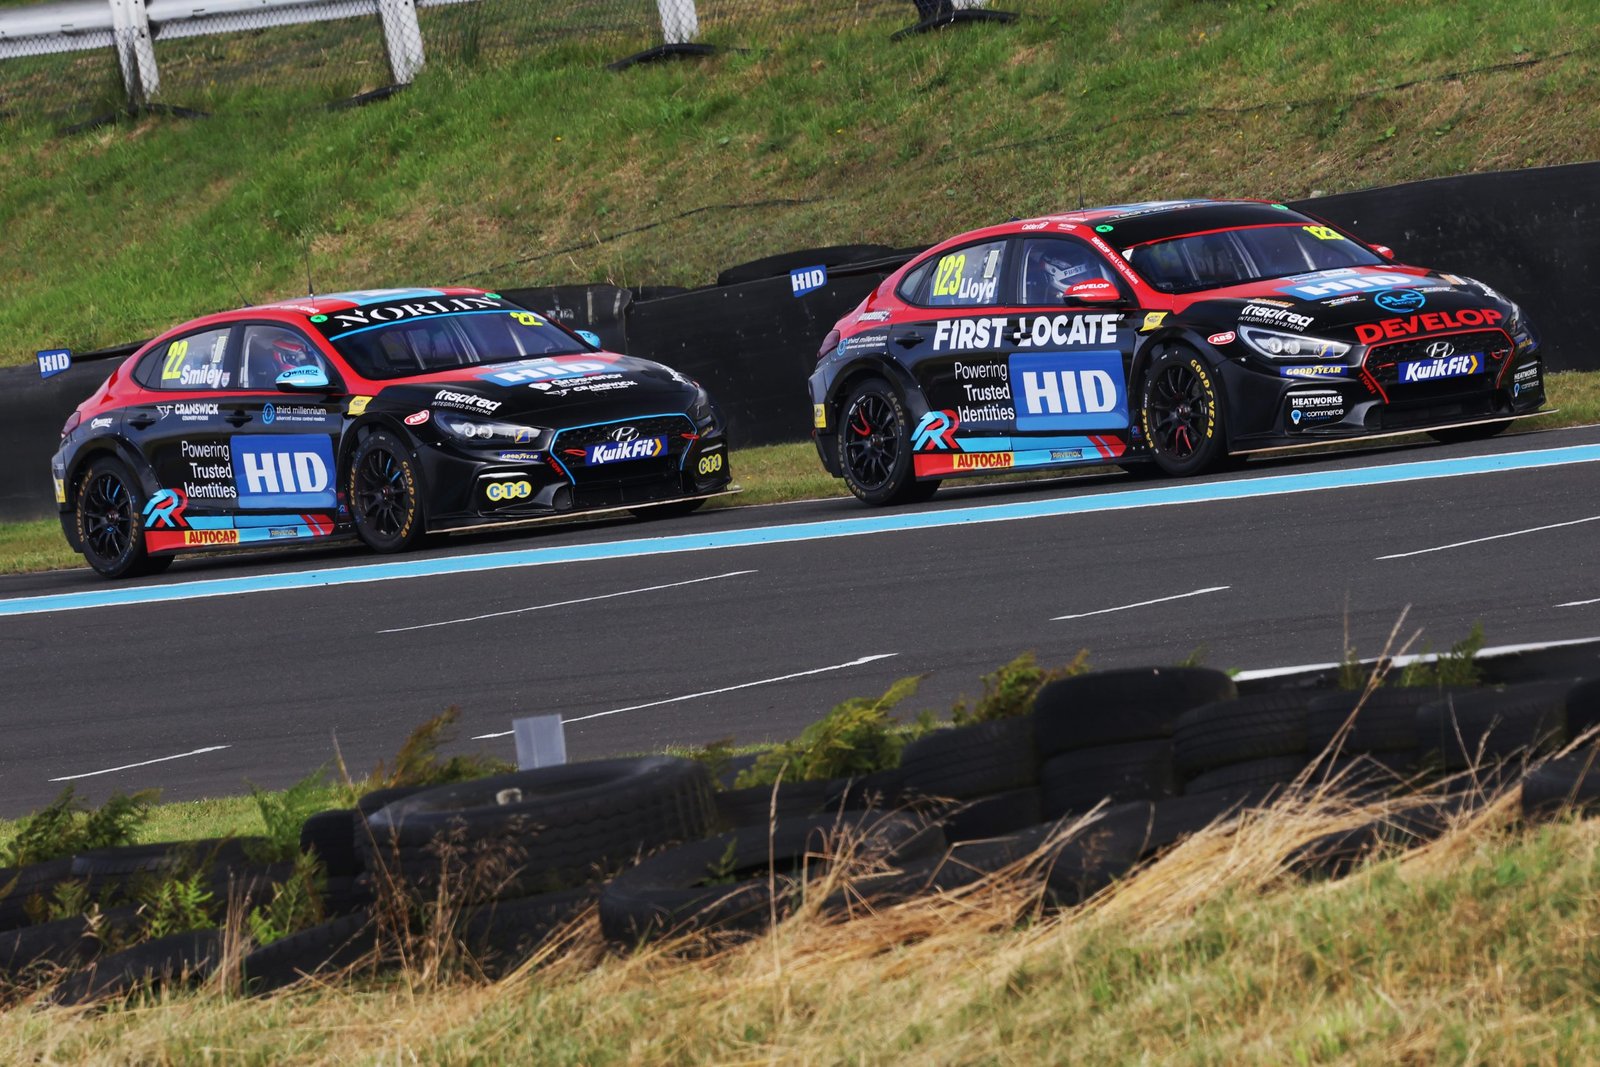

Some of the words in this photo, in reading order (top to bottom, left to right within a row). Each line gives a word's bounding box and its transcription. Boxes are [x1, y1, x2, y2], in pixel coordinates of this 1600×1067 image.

[791, 269, 825, 292] HID
[933, 254, 966, 296] 123
[958, 277, 996, 303] Lloyd
[1073, 284, 1110, 292] DEVELOP
[1296, 276, 1411, 296] HID
[334, 296, 501, 328] NORLIN
[509, 312, 543, 326] 22
[1354, 309, 1502, 345] DEVELOP
[1214, 333, 1233, 343] ABS
[38, 352, 70, 372] HID
[162, 340, 188, 380] 22
[179, 364, 223, 389] Smiley
[494, 363, 605, 382] HID
[954, 361, 1008, 381] Powering
[1286, 365, 1341, 376] GOODYEAR
[963, 384, 1011, 402] Trusted
[1022, 369, 1117, 414] HID
[1292, 395, 1343, 406] HEATWORKS
[174, 403, 219, 415] CRANSWICK
[276, 405, 291, 414] third
[292, 405, 327, 415] millennium
[958, 405, 1015, 423] Identities
[182, 440, 230, 461] Powering
[957, 453, 1011, 468] AUTOCAR
[189, 462, 233, 479] Trusted
[242, 452, 328, 493] HID
[184, 481, 237, 499] Identities
[188, 530, 237, 544] AUTOCAR
